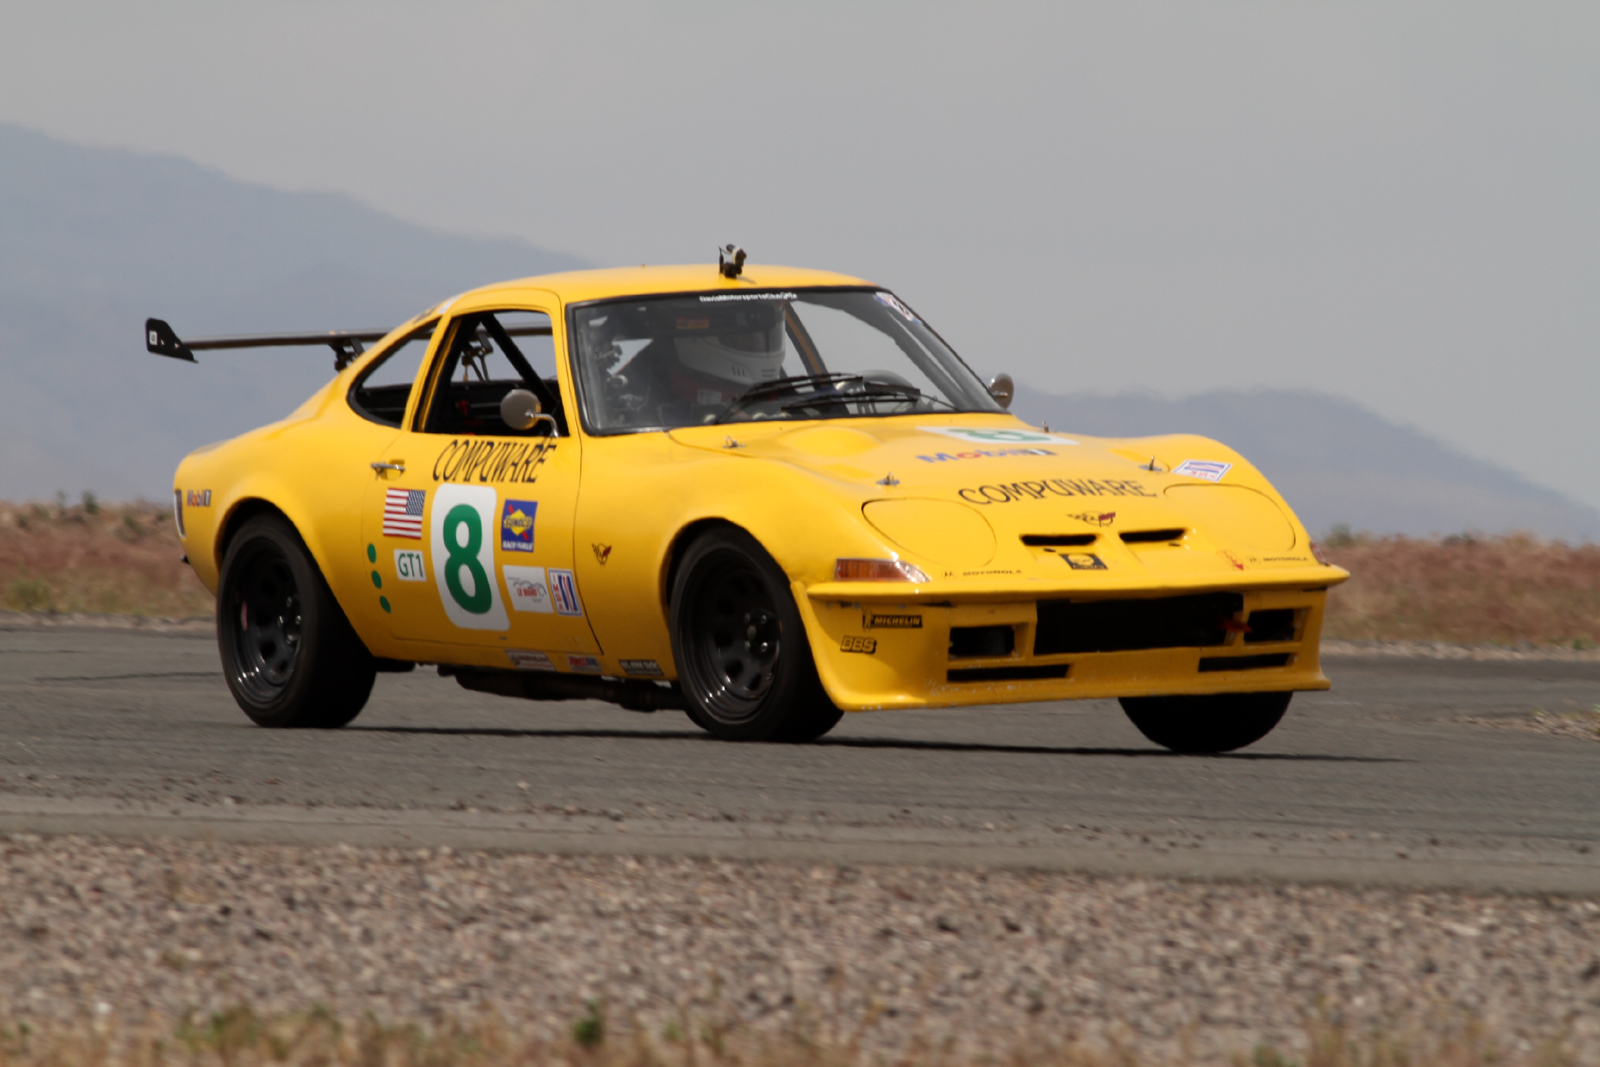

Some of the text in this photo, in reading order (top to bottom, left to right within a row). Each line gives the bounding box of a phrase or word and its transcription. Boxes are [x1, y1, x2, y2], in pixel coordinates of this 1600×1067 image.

[432, 437, 558, 483] COMPUWARE
[957, 479, 1159, 505] COMPUWARE
[398, 552, 424, 578] GT1
[443, 503, 493, 615] 8
[874, 616, 921, 626] MICHELIN
[841, 635, 877, 654] BBS
